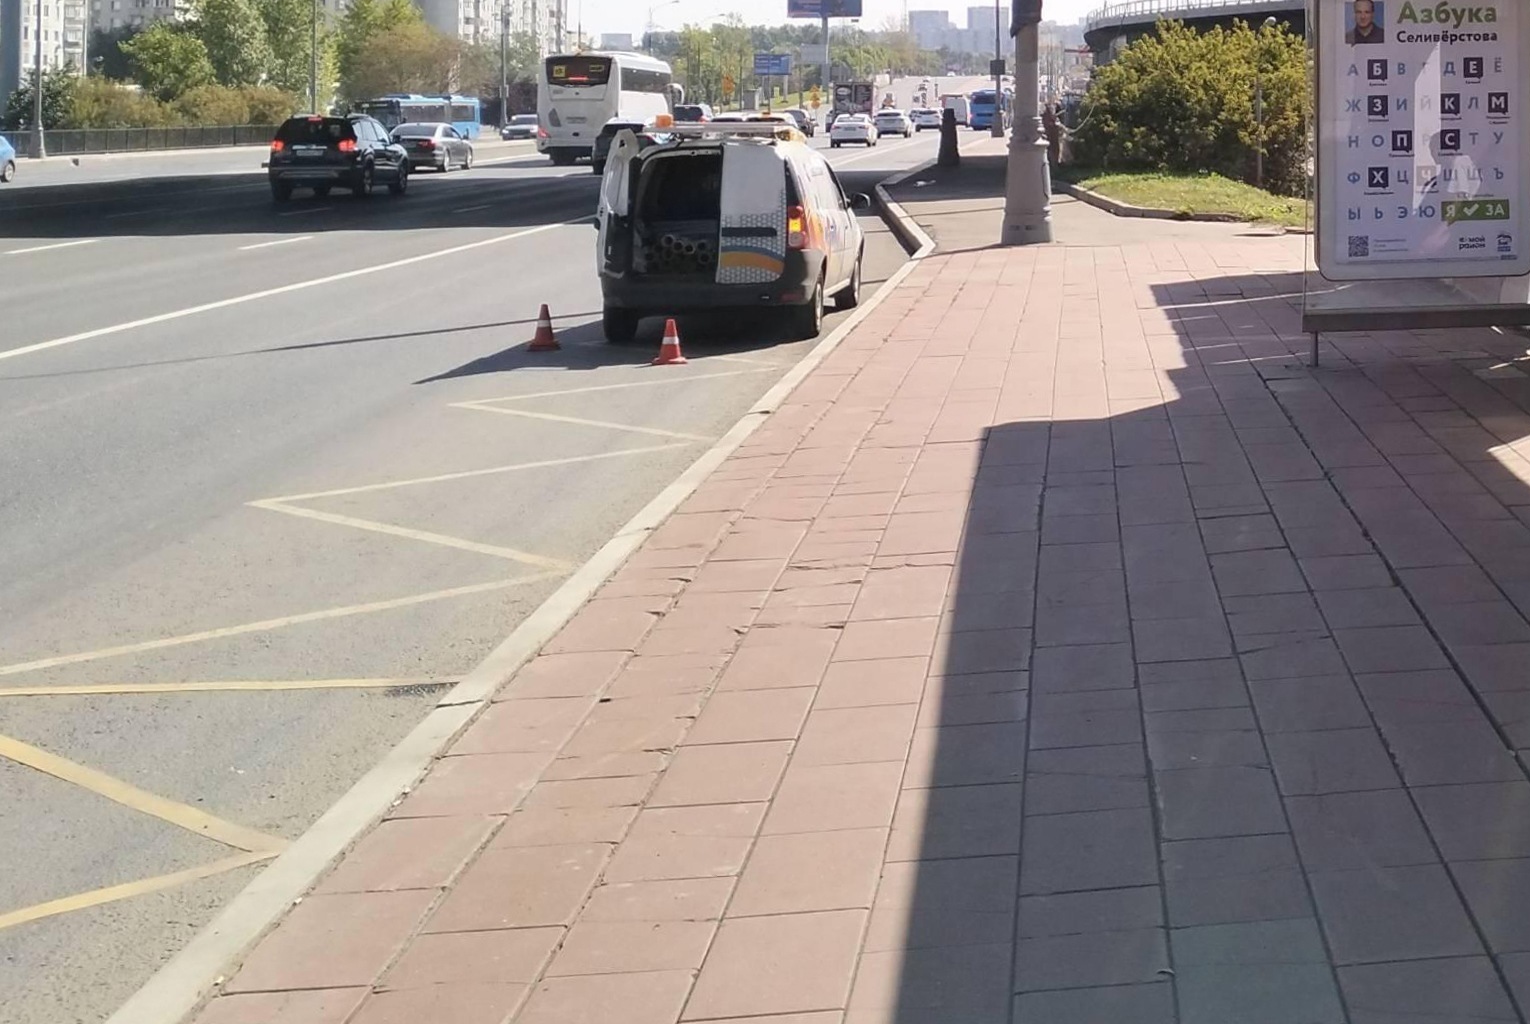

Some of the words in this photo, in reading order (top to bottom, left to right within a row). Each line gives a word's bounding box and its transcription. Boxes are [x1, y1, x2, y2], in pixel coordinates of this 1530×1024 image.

[1397, 0, 1497, 29] Азбука
[1396, 31, 1498, 45] Селивёрстова
[1347, 64, 1359, 76] А
[1372, 63, 1382, 76] Б
[1397, 63, 1406, 75] В
[1443, 61, 1456, 76] Д
[1469, 60, 1478, 74] Е
[1494, 57, 1502, 73] Ё
[1346, 99, 1361, 112] Ж
[1372, 99, 1382, 112] З
[1396, 98, 1407, 111] И
[1420, 95, 1431, 110] Й
[1445, 97, 1455, 110] К
[1467, 96, 1478, 109] Л
[1491, 96, 1505, 108] М
[1348, 135, 1359, 148] Н
[1371, 135, 1384, 147] О
[1396, 134, 1407, 147] П
[1444, 133, 1455, 146] С
[1469, 132, 1479, 145] Т
[1493, 132, 1504, 144] У
[1347, 171, 1360, 184] Ф
[1372, 171, 1384, 184] Х
[1397, 170, 1409, 185] Ц
[1493, 168, 1504, 180] Ъ
[1348, 207, 1361, 220] Ы
[1375, 207, 1383, 219] Ь
[1398, 206, 1408, 218] Э
[1419, 205, 1436, 218] Ю
[1445, 204, 1456, 217] Я
[1485, 204, 1505, 216] ЗА
